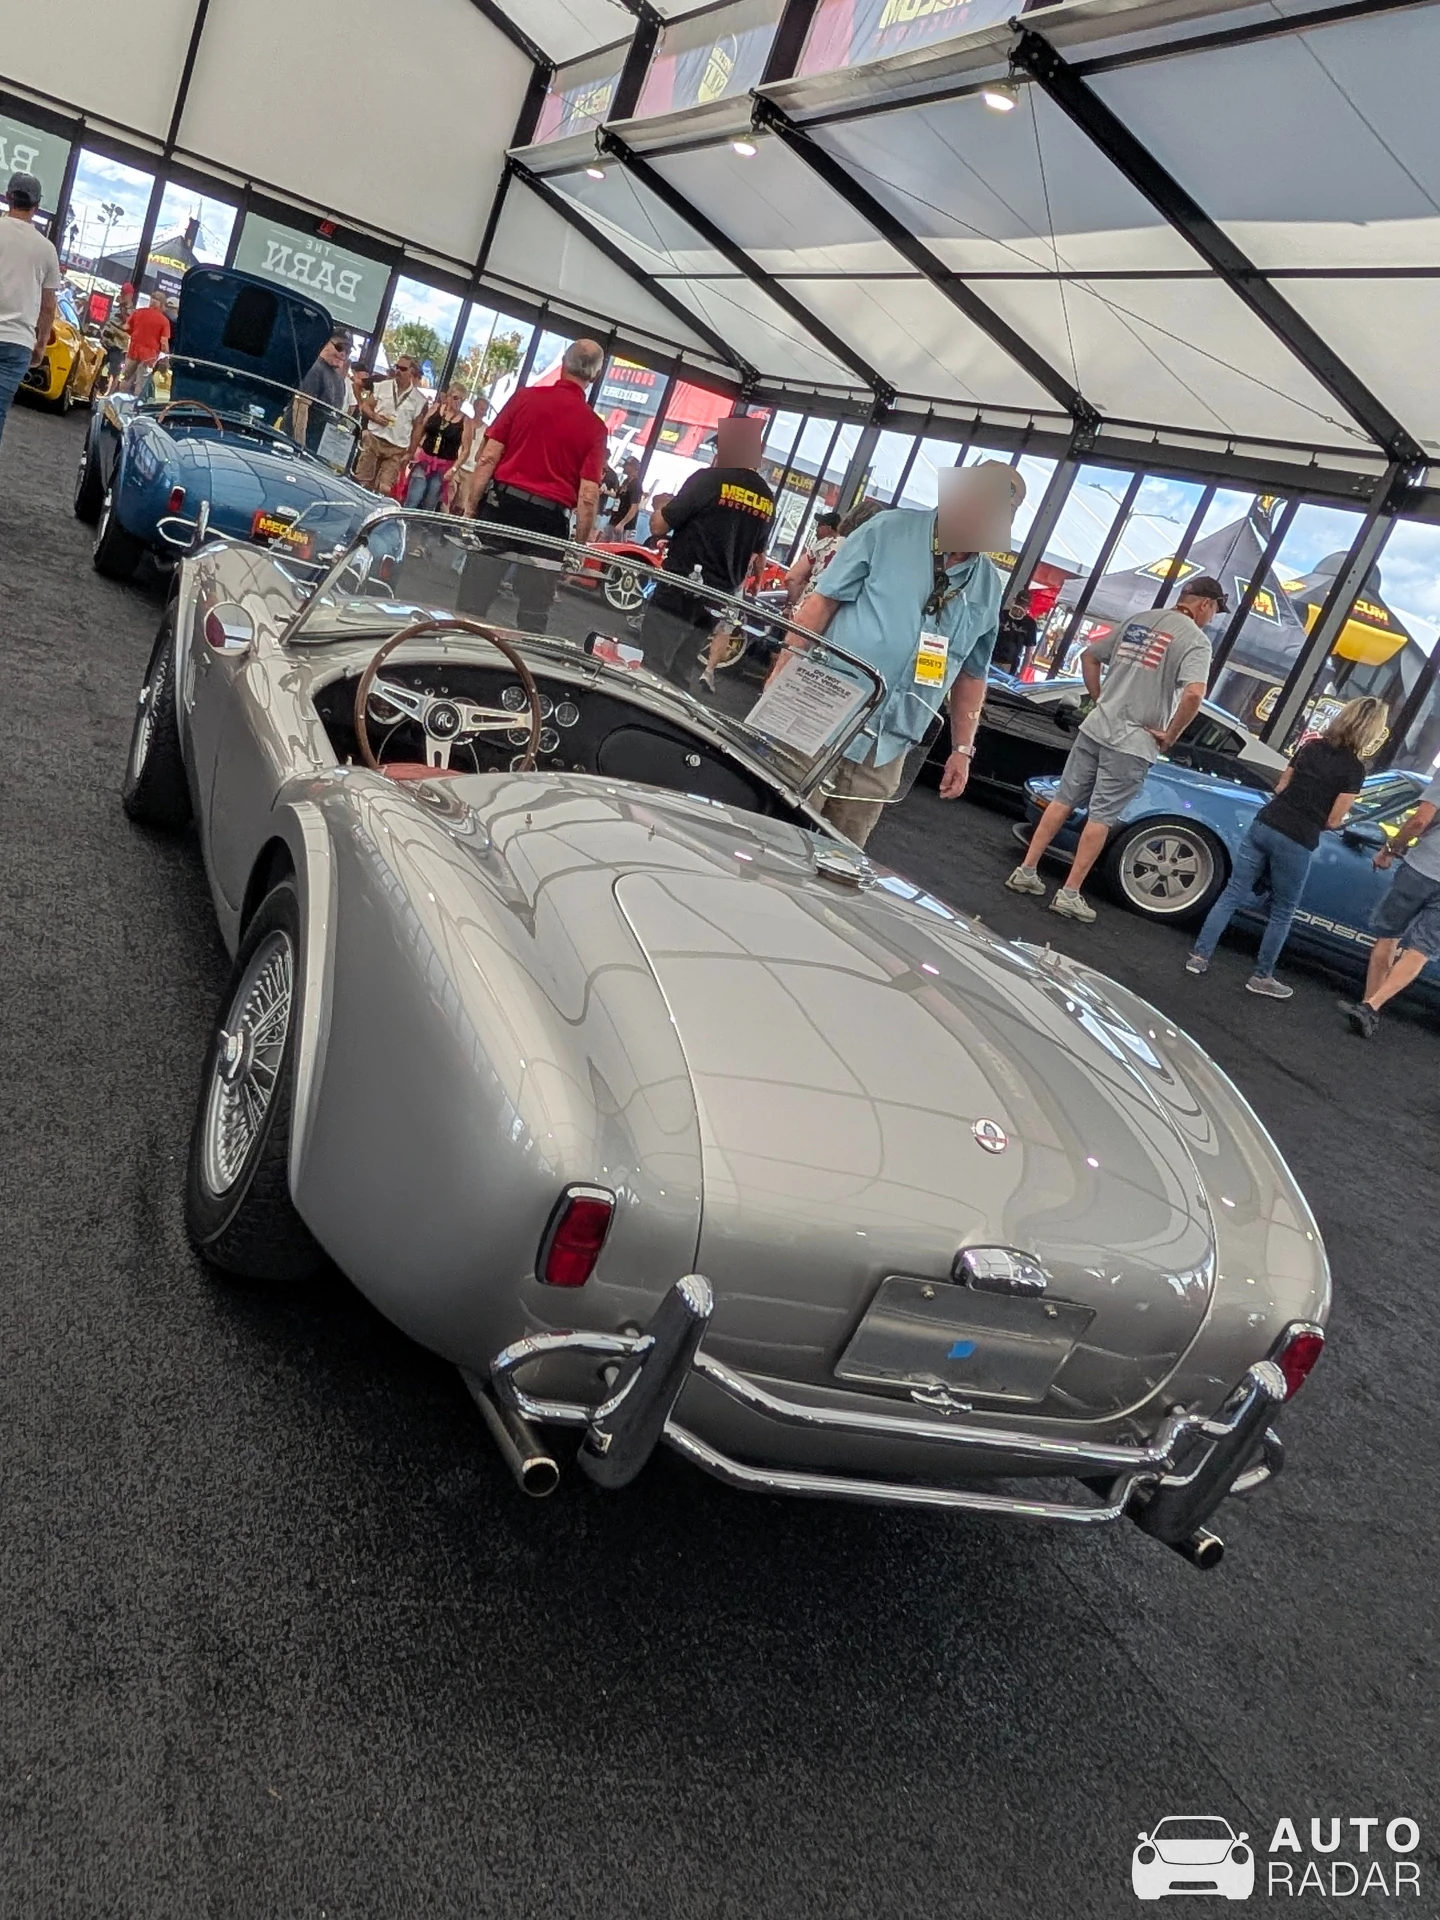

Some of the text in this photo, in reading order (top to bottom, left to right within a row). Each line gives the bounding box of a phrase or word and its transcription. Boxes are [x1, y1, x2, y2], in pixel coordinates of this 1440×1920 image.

[718, 498, 771, 524] AUCTIONS
[721, 483, 774, 517] MECUM
[259, 517, 309, 546] MECUM
[796, 666, 852, 698] START VEHICLE
[813, 668, 842, 685] DO NOT
